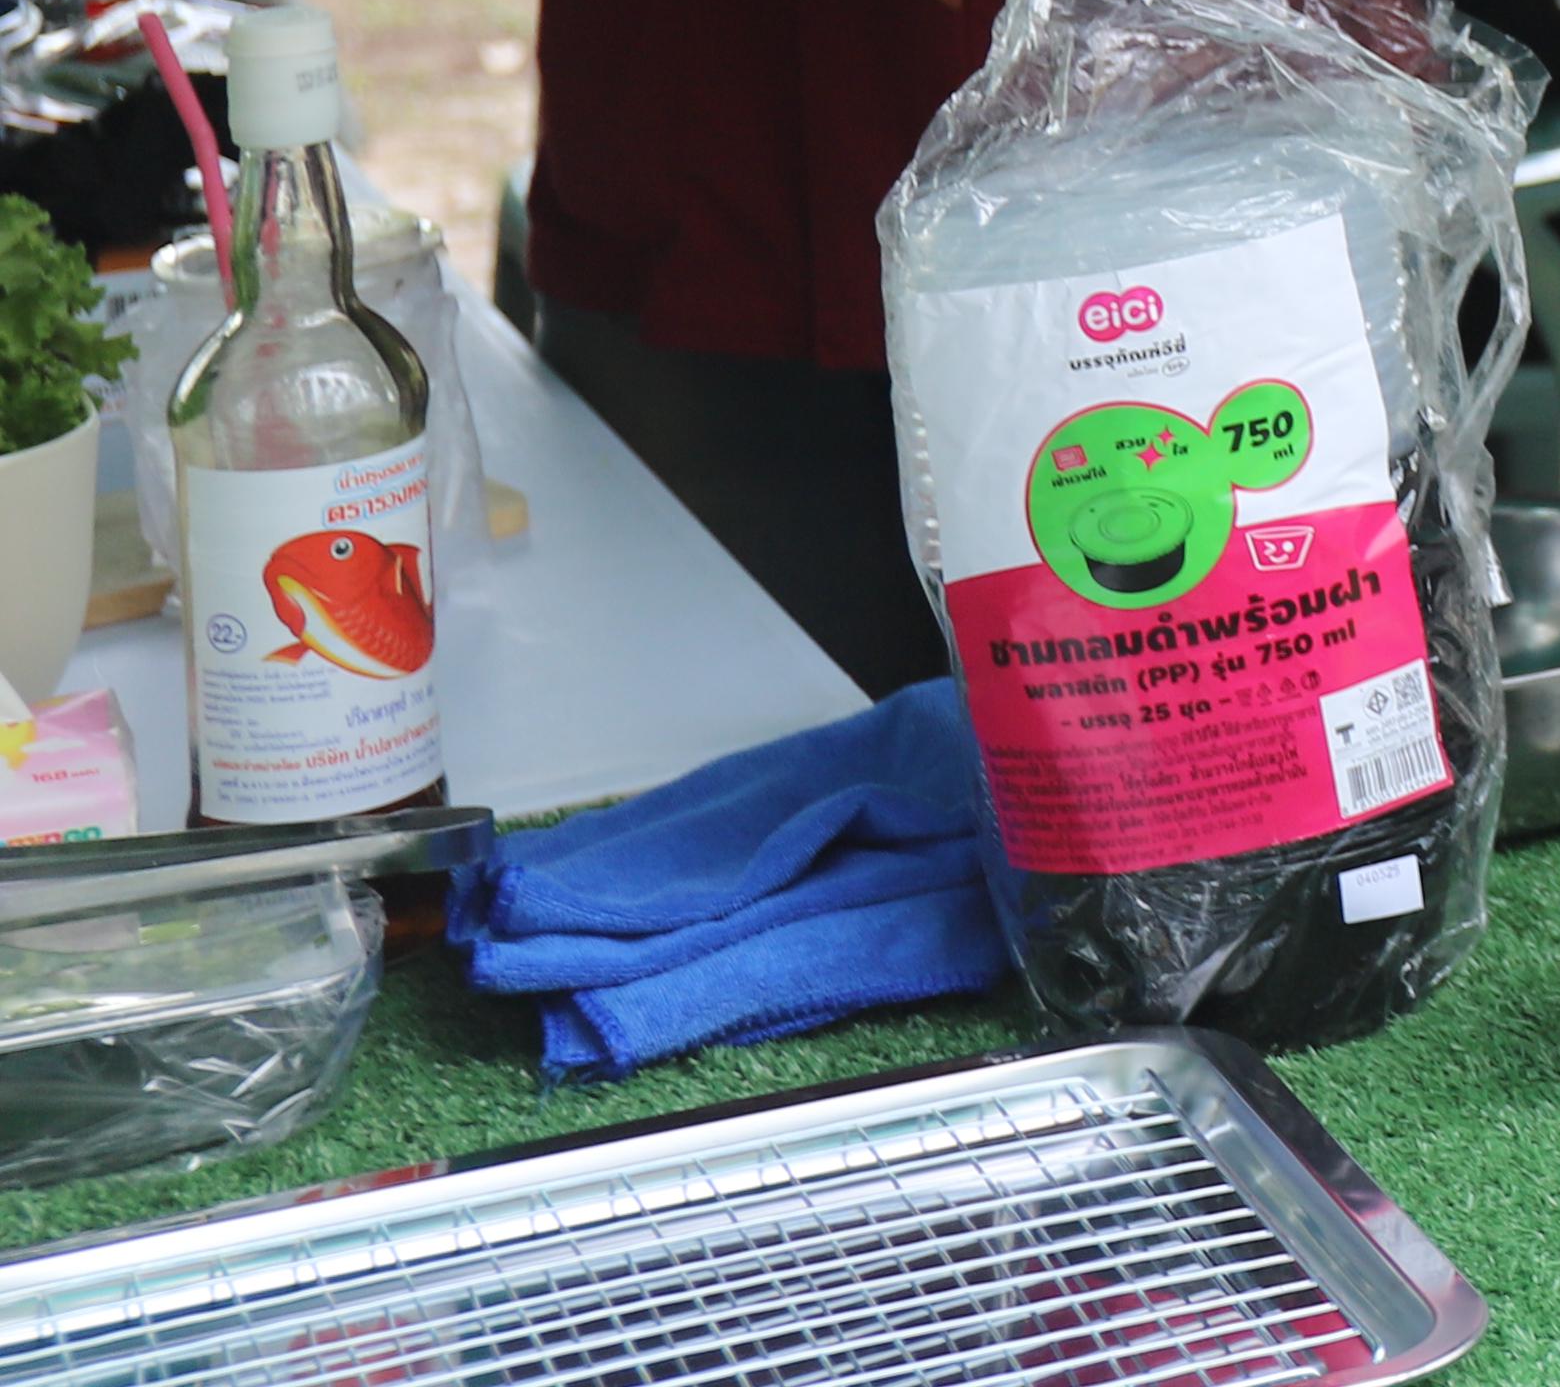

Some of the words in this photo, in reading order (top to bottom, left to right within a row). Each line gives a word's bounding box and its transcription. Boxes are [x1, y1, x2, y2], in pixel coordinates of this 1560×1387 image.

[1222, 410, 1295, 454] 750
[1272, 445, 1295, 461] ml
[988, 567, 1382, 668] ชามกลมดำพร้อมฝา
[1024, 670, 1128, 700] พลาสติก
[1137, 659, 1201, 692] (PP)
[1210, 651, 1247, 681] รุ่น
[1254, 636, 1313, 666] 750
[1322, 619, 1357, 648] ml
[1079, 706, 1132, 733] บรรจุ
[1139, 695, 1171, 725] 25
[1179, 693, 1212, 725] ชุด
